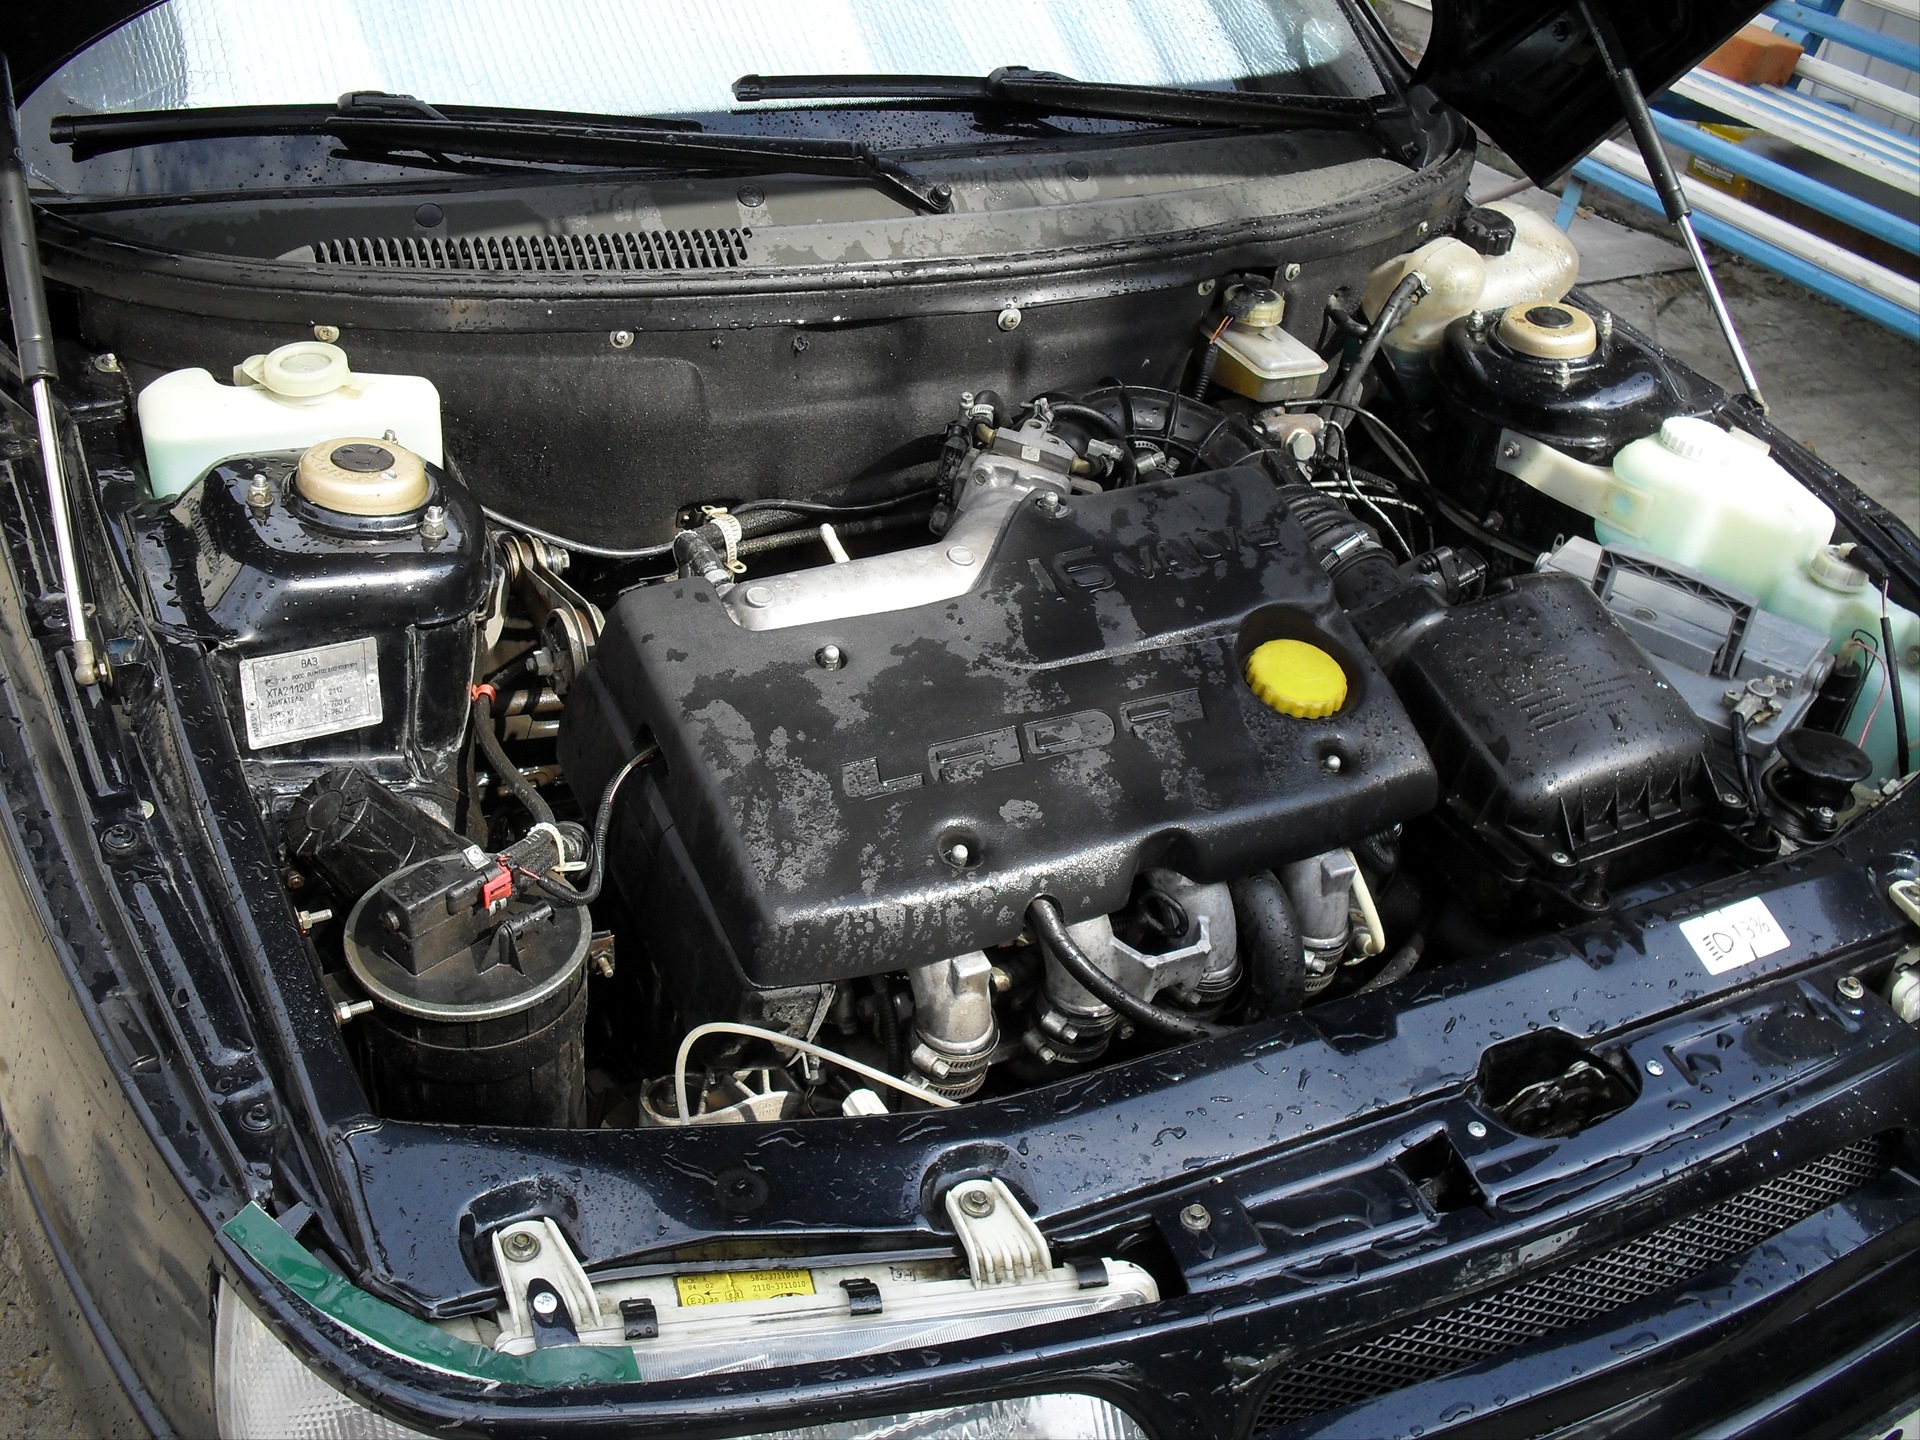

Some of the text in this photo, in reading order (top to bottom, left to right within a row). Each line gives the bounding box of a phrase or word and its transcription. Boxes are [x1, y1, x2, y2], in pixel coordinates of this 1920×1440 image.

[301, 657, 318, 669] ВАЗ
[266, 680, 315, 699] XTA211200
[327, 685, 344, 696] 2112
[267, 696, 305, 709] ДВИГАТЕЛЬ
[841, 687, 1206, 802] LADA
[752, 1281, 807, 1292] 2110-3711010
